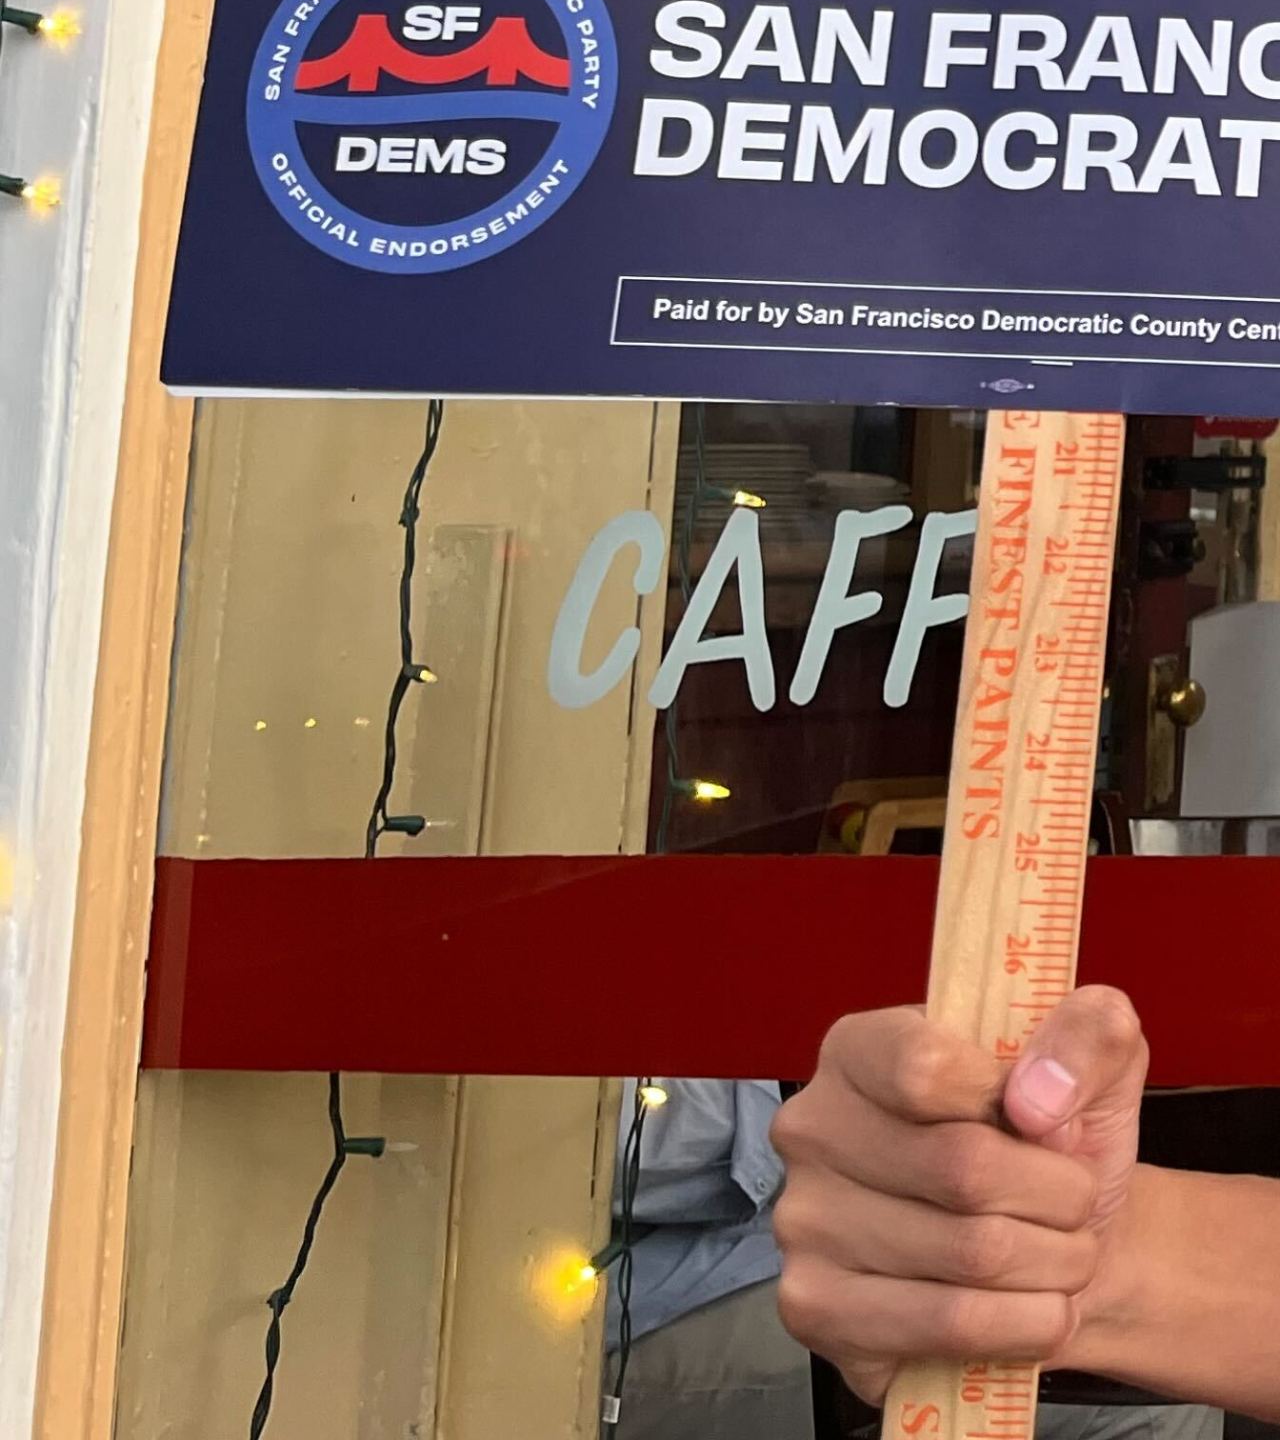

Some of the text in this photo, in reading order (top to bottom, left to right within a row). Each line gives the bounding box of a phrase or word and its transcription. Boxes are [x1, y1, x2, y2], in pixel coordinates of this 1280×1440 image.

[402, 5, 481, 40] SF
[648, 0, 911, 87] SAN
[264, 44, 291, 101] SAN
[576, 19, 601, 109] PARTY
[335, 136, 507, 176] DEMS
[271, 152, 570, 257] OFFICIAL ENDORSEMENT
[652, 297, 709, 321] Paid
[716, 299, 748, 322] for
[757, 301, 790, 328] by
[796, 303, 844, 326] San
[851, 305, 975, 331] Francisco
[981, 308, 1124, 336] Democratic
[1129, 313, 1222, 344] County
